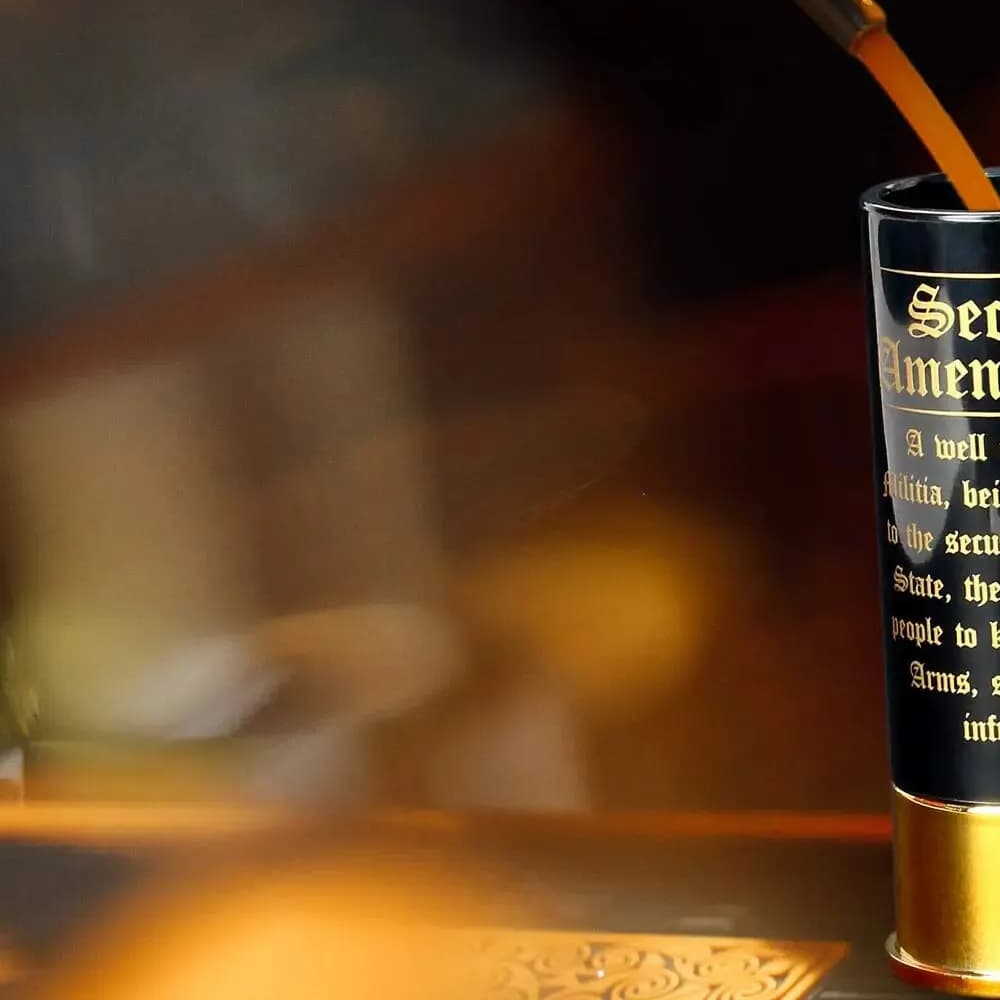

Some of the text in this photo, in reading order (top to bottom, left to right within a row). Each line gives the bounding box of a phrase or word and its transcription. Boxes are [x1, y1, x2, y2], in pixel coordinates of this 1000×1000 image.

[906, 428, 925, 457] A
[934, 432, 988, 462] well
[887, 519, 898, 545] to
[906, 523, 933, 554] the
[893, 565, 952, 603] State,
[891, 615, 943, 648] people
[955, 622, 978, 648] to
[910, 660, 978, 698] Arms,
